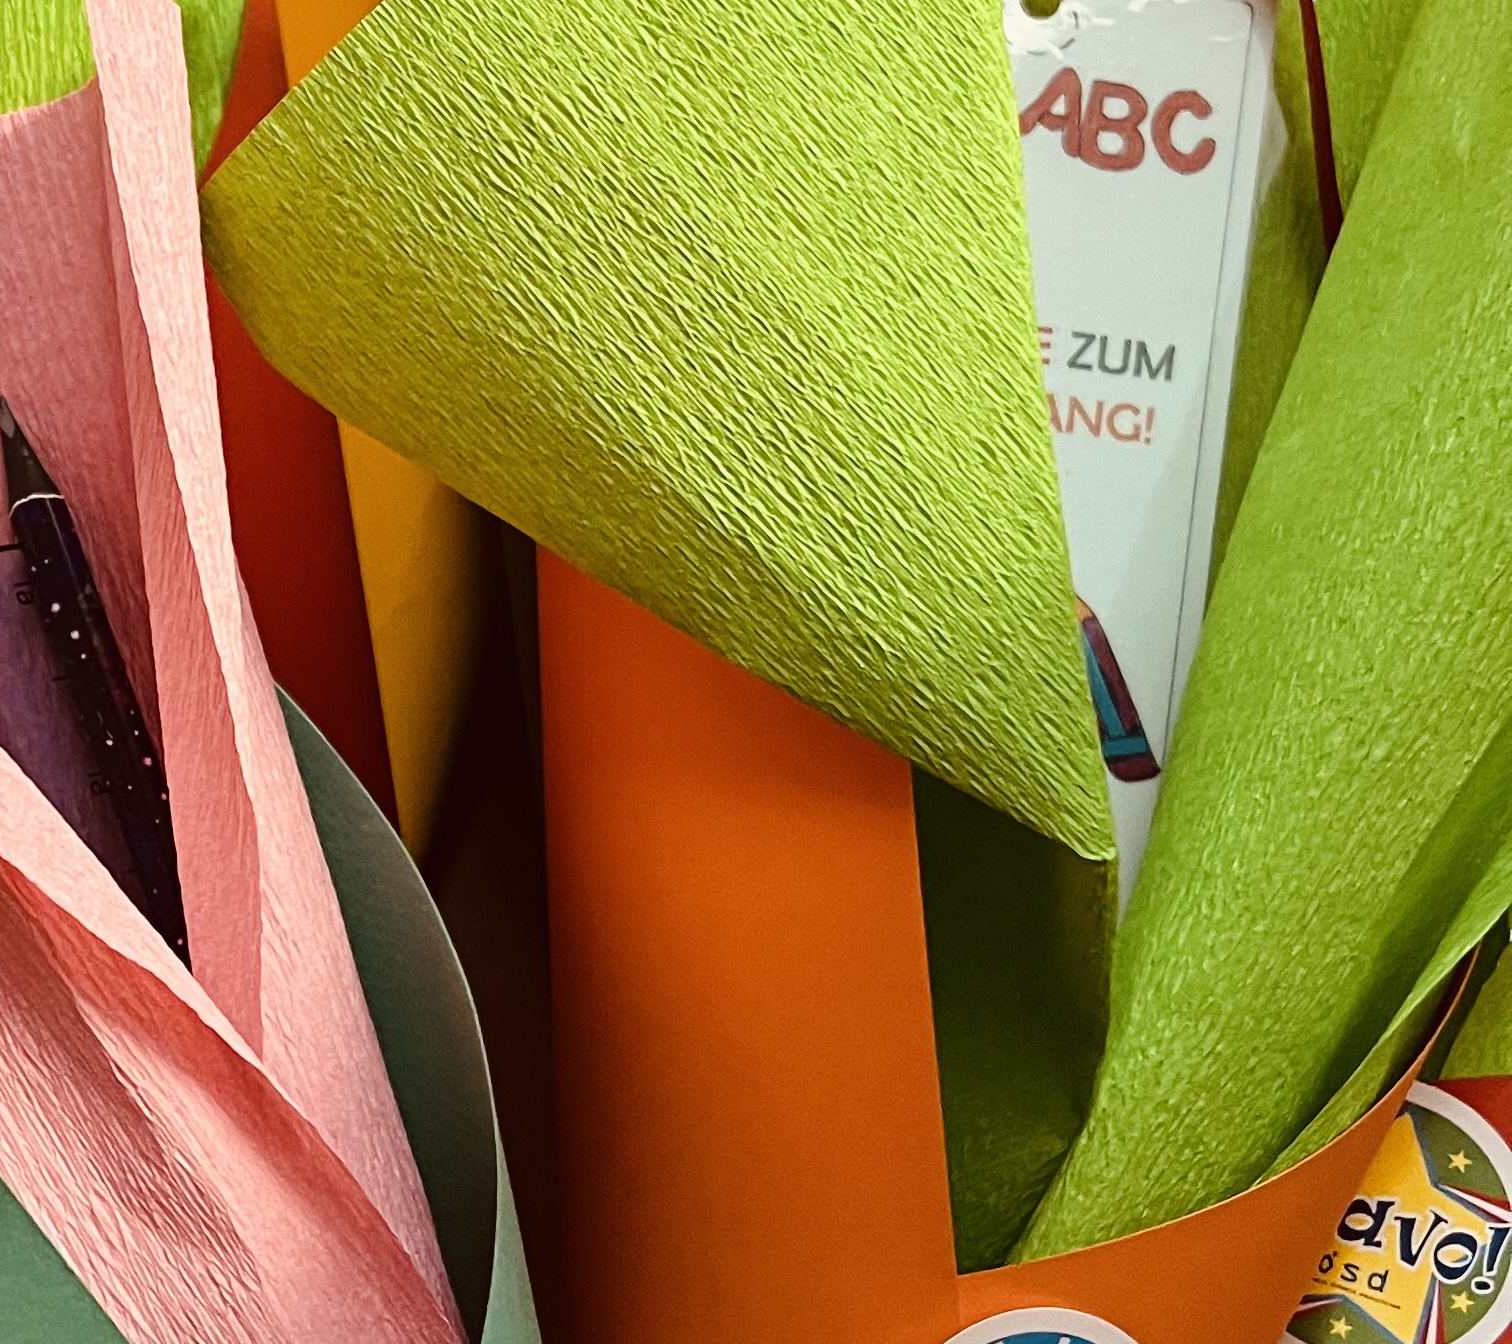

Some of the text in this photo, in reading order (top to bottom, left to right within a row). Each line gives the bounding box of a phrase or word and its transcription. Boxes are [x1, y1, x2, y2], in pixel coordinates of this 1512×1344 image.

[1019, 66, 1216, 176] ABC
[1066, 330, 1176, 382] ZUM
[1336, 1199, 1510, 1291] avo!
